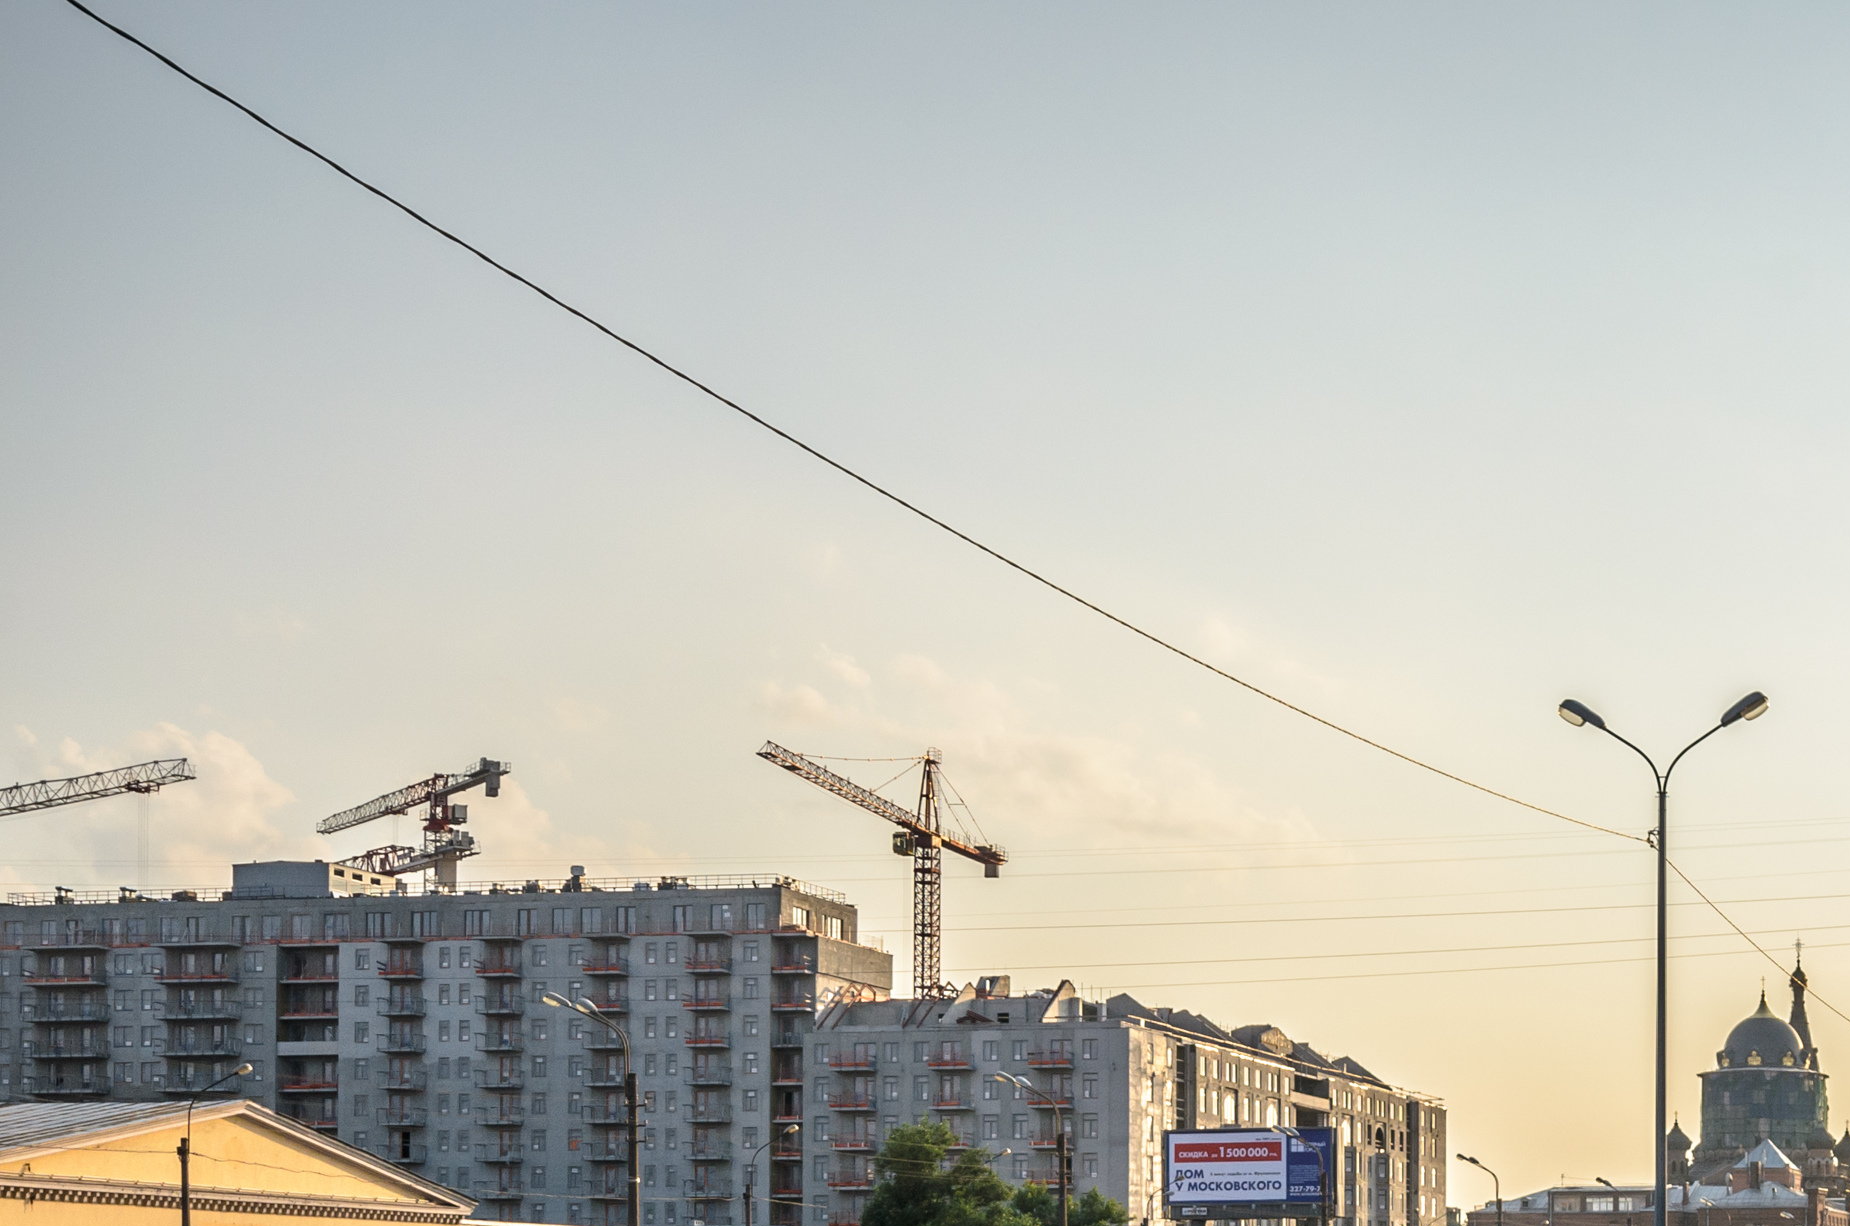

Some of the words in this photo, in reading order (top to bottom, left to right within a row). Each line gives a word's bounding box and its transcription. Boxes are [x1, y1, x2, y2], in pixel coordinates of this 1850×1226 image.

[1175, 1169, 1204, 1179] ДОМ
[1175, 1182, 1183, 1191] У
[1187, 1180, 1282, 1191] МОСКОВСКОГО
